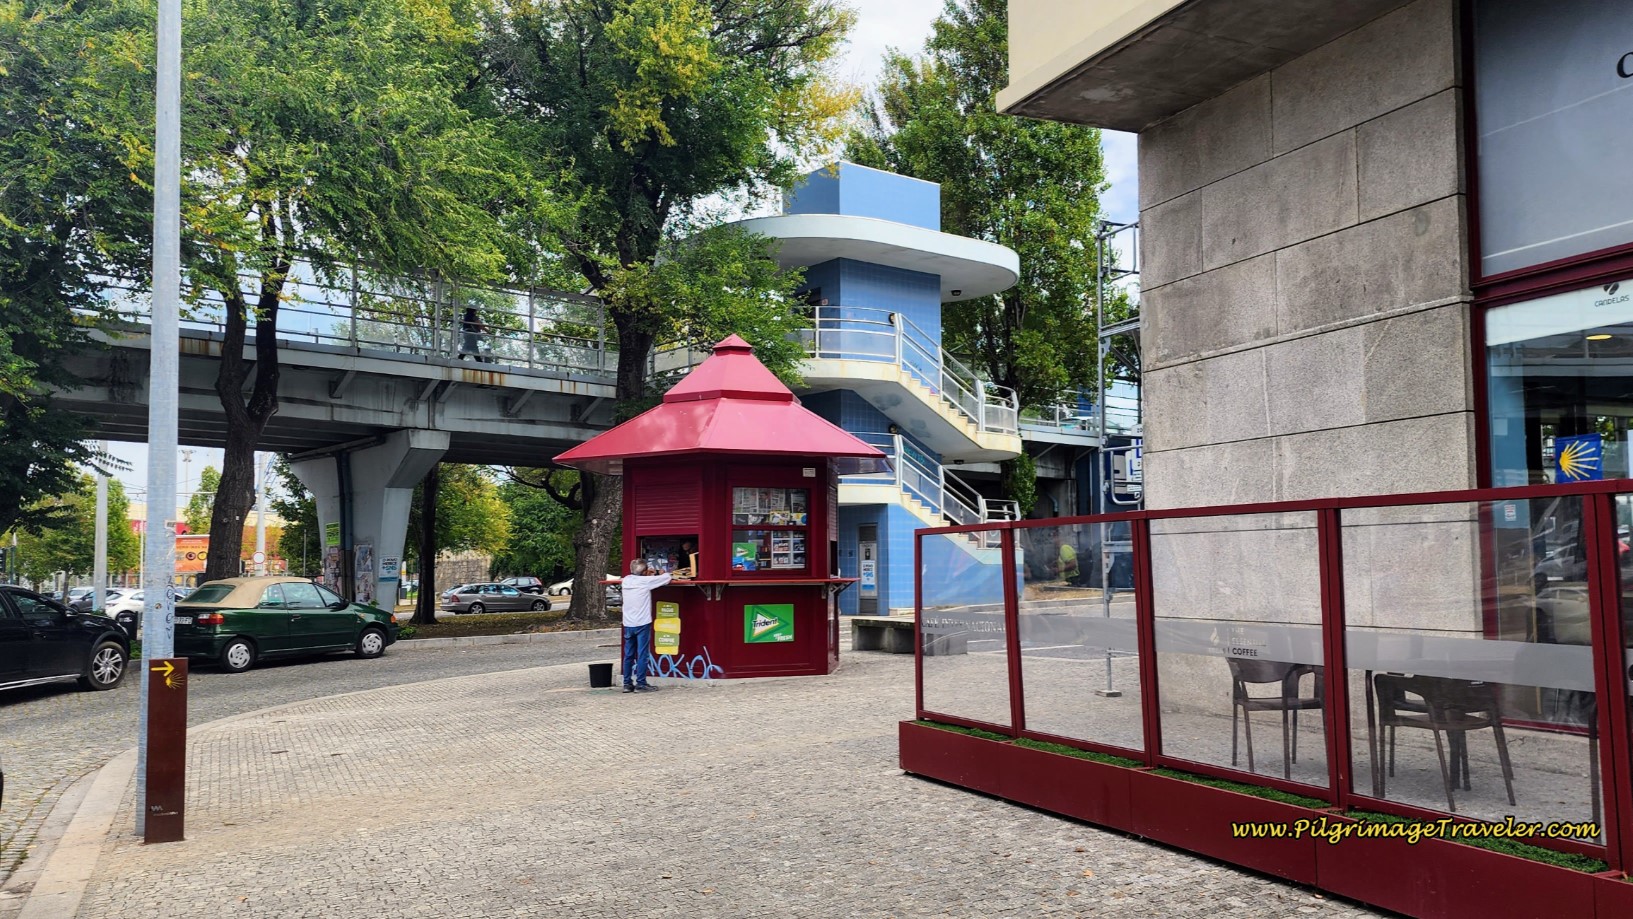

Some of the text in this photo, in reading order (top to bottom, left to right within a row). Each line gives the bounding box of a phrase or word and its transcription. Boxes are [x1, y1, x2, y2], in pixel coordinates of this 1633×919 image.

[1594, 294, 1630, 307] CANDELAS
[752, 617, 778, 628] Trident
[1232, 647, 1258, 656] COFFEE
